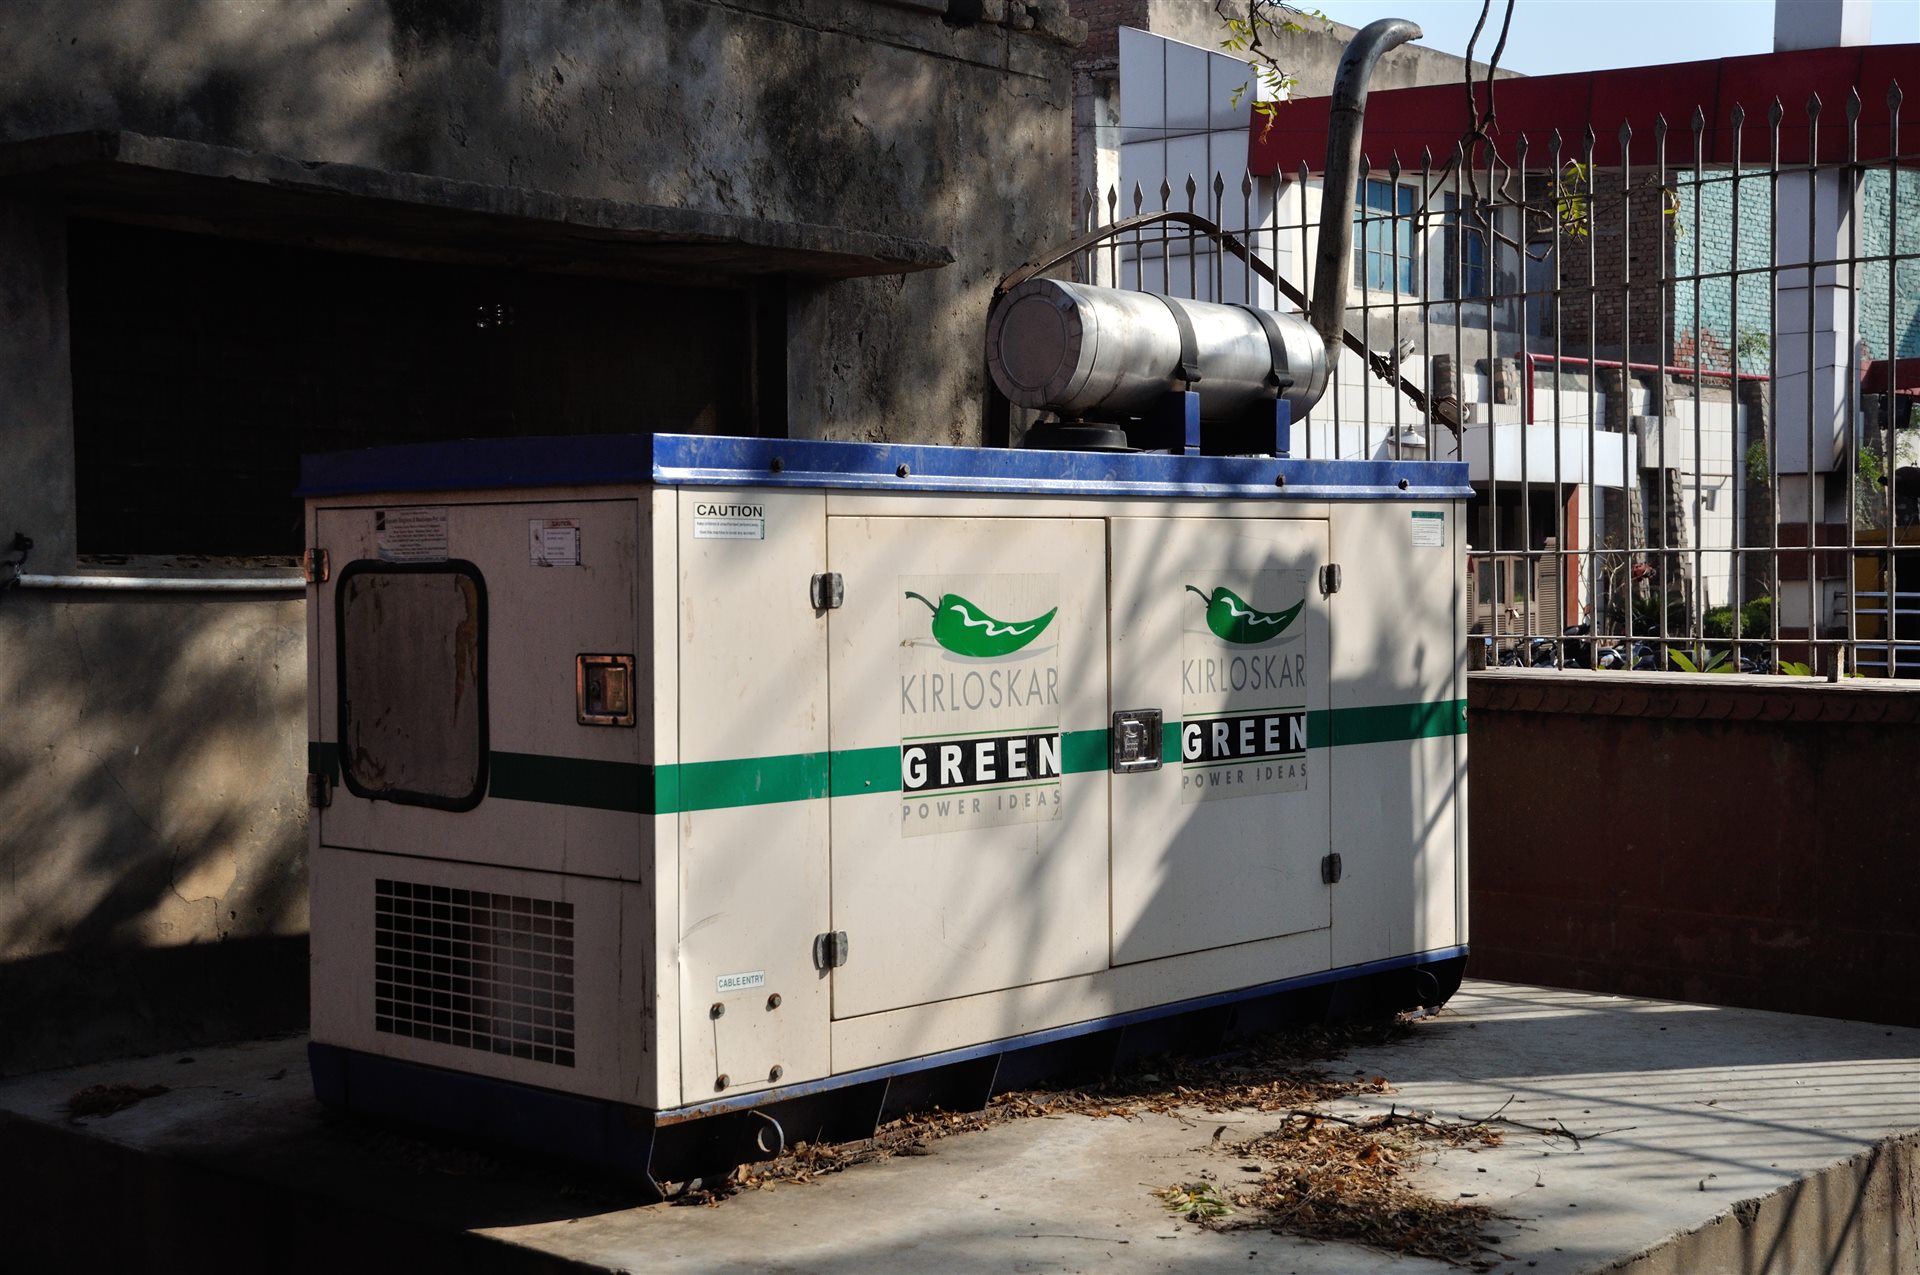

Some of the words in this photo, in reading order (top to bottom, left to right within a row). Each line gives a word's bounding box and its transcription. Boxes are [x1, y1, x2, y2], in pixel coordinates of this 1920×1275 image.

[697, 504, 763, 517] CAUTION
[901, 667, 1060, 715] KIRLOSKAR
[1182, 654, 1306, 695] KIRLOSKAR
[1182, 715, 1307, 761] GREEN
[902, 736, 1060, 789] GREEN
[1182, 769, 1244, 790] POWER
[1256, 763, 1307, 781] IDEAS
[903, 797, 981, 822] POWER
[997, 789, 1061, 811] IDEAS
[718, 977, 741, 988] CABLE
[741, 974, 764, 985] ENTRY
